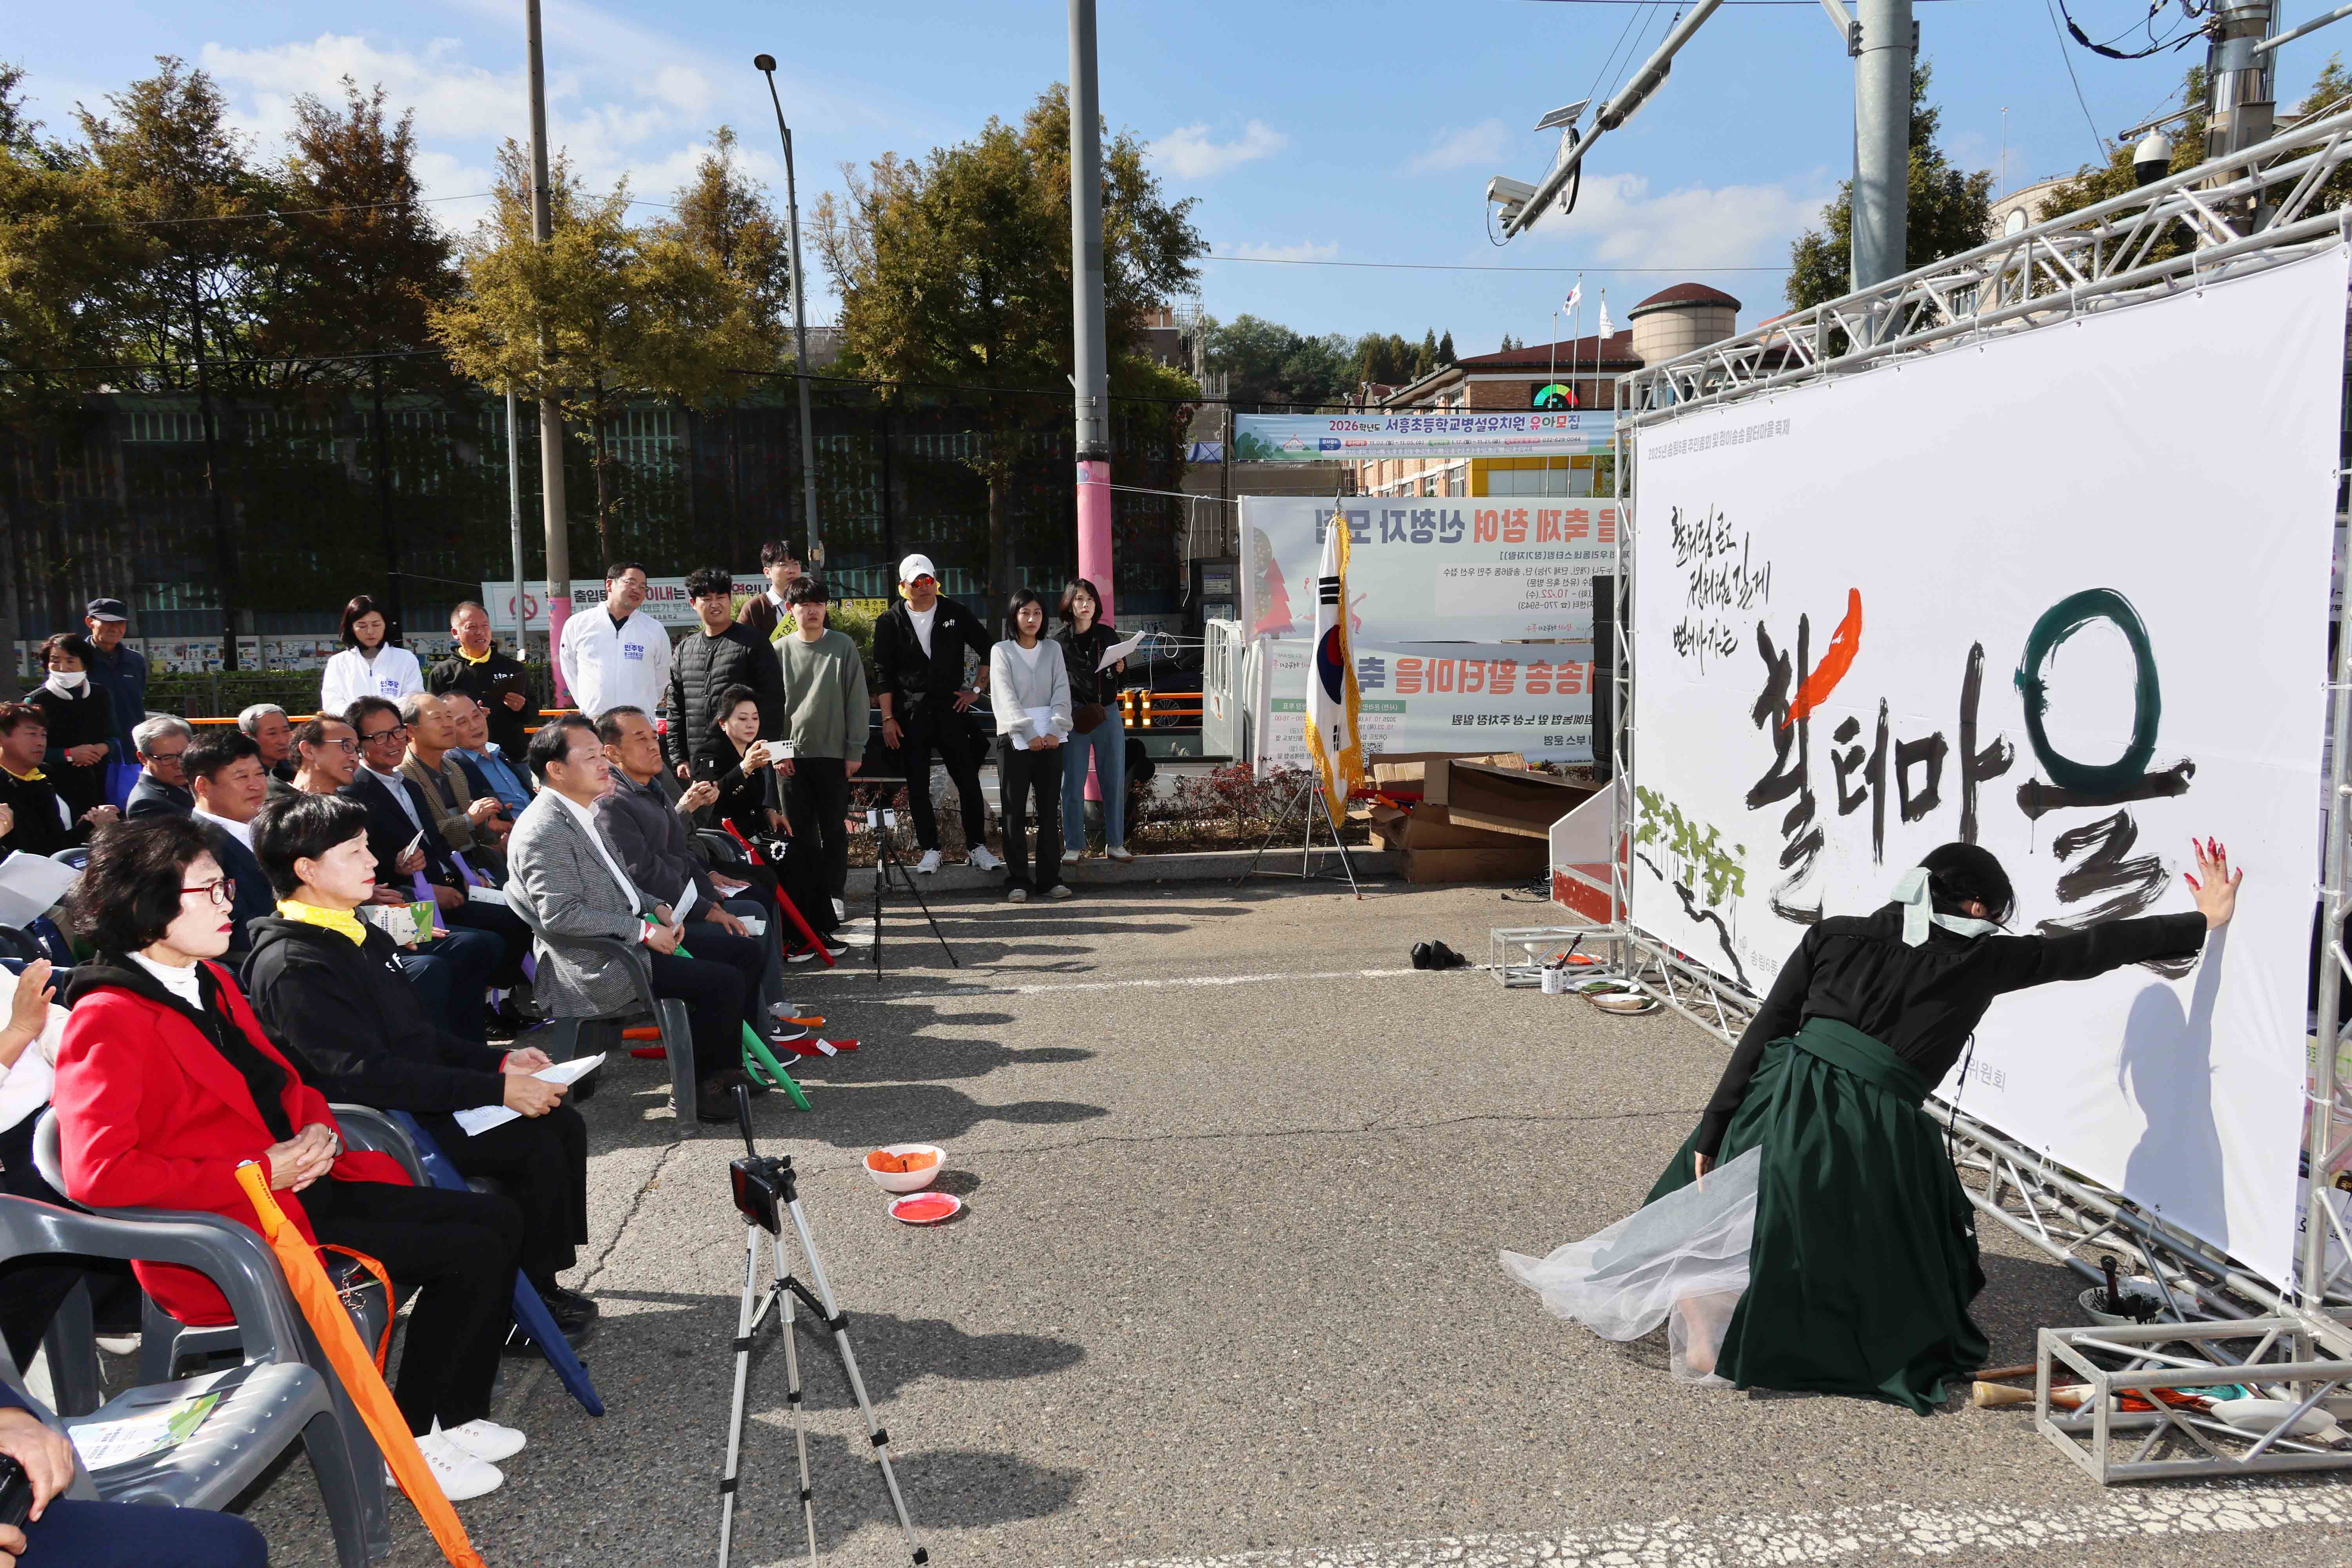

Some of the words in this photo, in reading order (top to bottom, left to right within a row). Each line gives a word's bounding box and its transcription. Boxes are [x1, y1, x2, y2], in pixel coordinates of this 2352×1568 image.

[1329, 420, 1380, 432] 2026학년도
[1385, 416, 1525, 434] 서흥초등학교병설유치원
[1530, 415, 1580, 430] 유아모집
[1750, 950, 1779, 977] 송림6동
